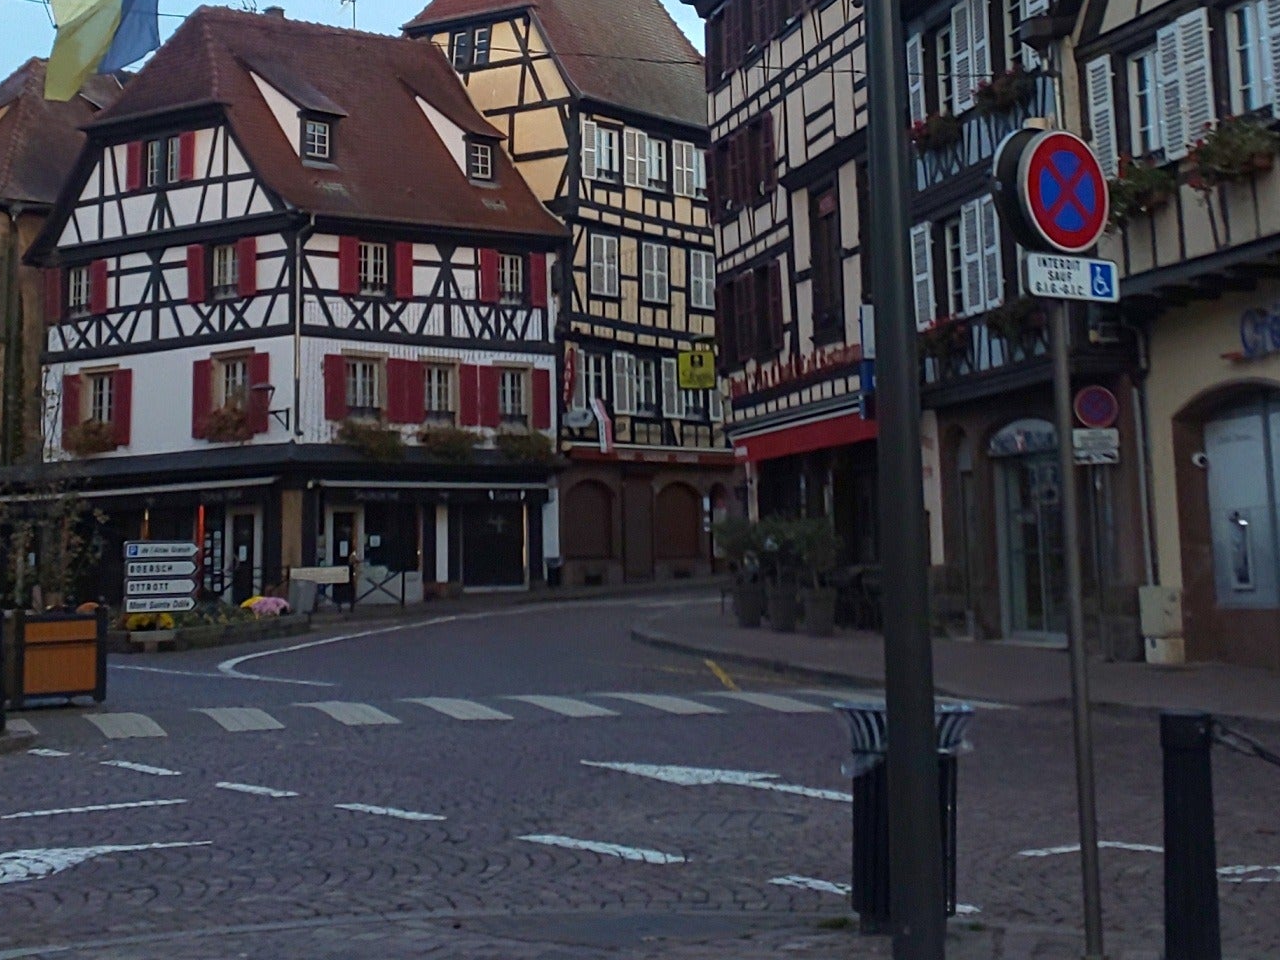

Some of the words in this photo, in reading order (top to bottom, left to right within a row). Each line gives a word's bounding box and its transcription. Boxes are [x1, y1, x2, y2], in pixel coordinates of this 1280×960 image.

[1036, 256, 1081, 272] INTERDIT
[1047, 271, 1073, 283] SAUF
[130, 564, 173, 574] BOERSCH
[129, 582, 169, 592] OTTROTT
